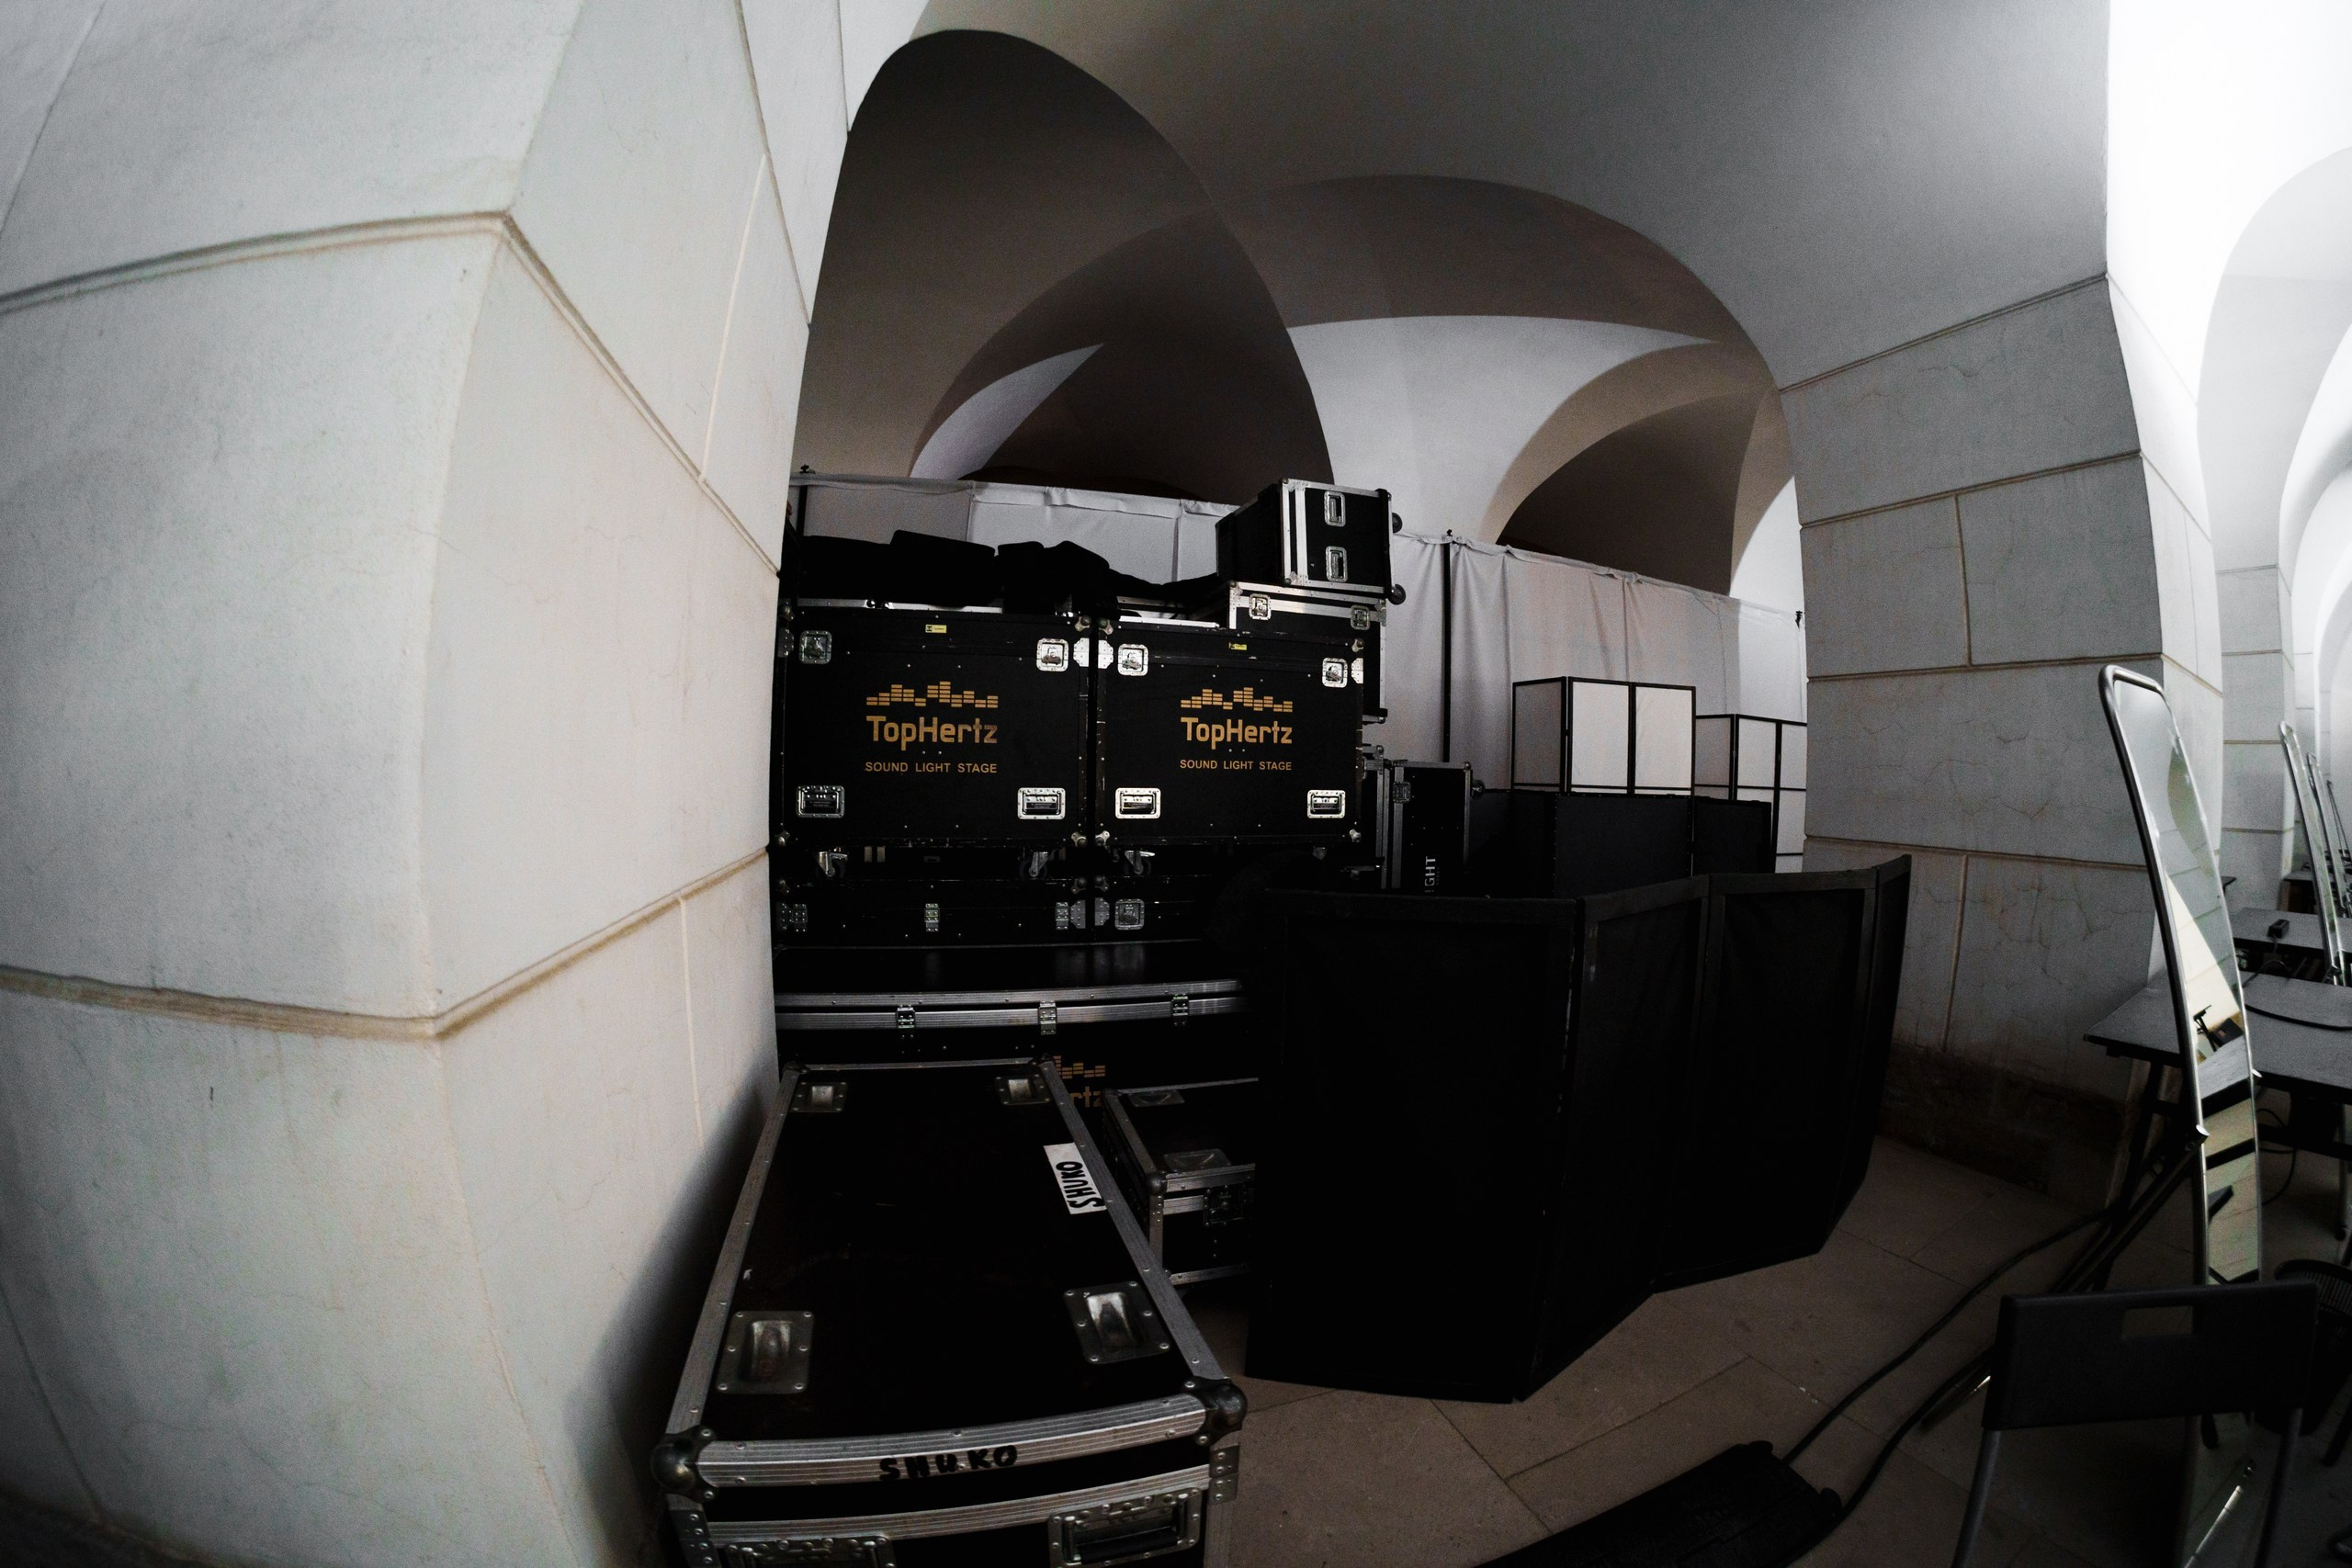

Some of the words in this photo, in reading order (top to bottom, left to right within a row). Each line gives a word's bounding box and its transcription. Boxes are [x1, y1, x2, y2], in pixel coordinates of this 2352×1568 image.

[865, 715, 998, 751] TopHertz
[1180, 716, 1293, 750] TopHertz
[865, 761, 909, 773] SOUND
[915, 762, 952, 773] LIGHT
[957, 763, 998, 773] STAGE
[1180, 760, 1218, 770] SOUND
[1223, 761, 1254, 770] LIGHT
[1259, 761, 1293, 771] STAGE
[1424, 855, 1436, 894] IGHT
[1056, 1161, 1106, 1208] SHUKO
[879, 1445, 1018, 1482] SHUKO
